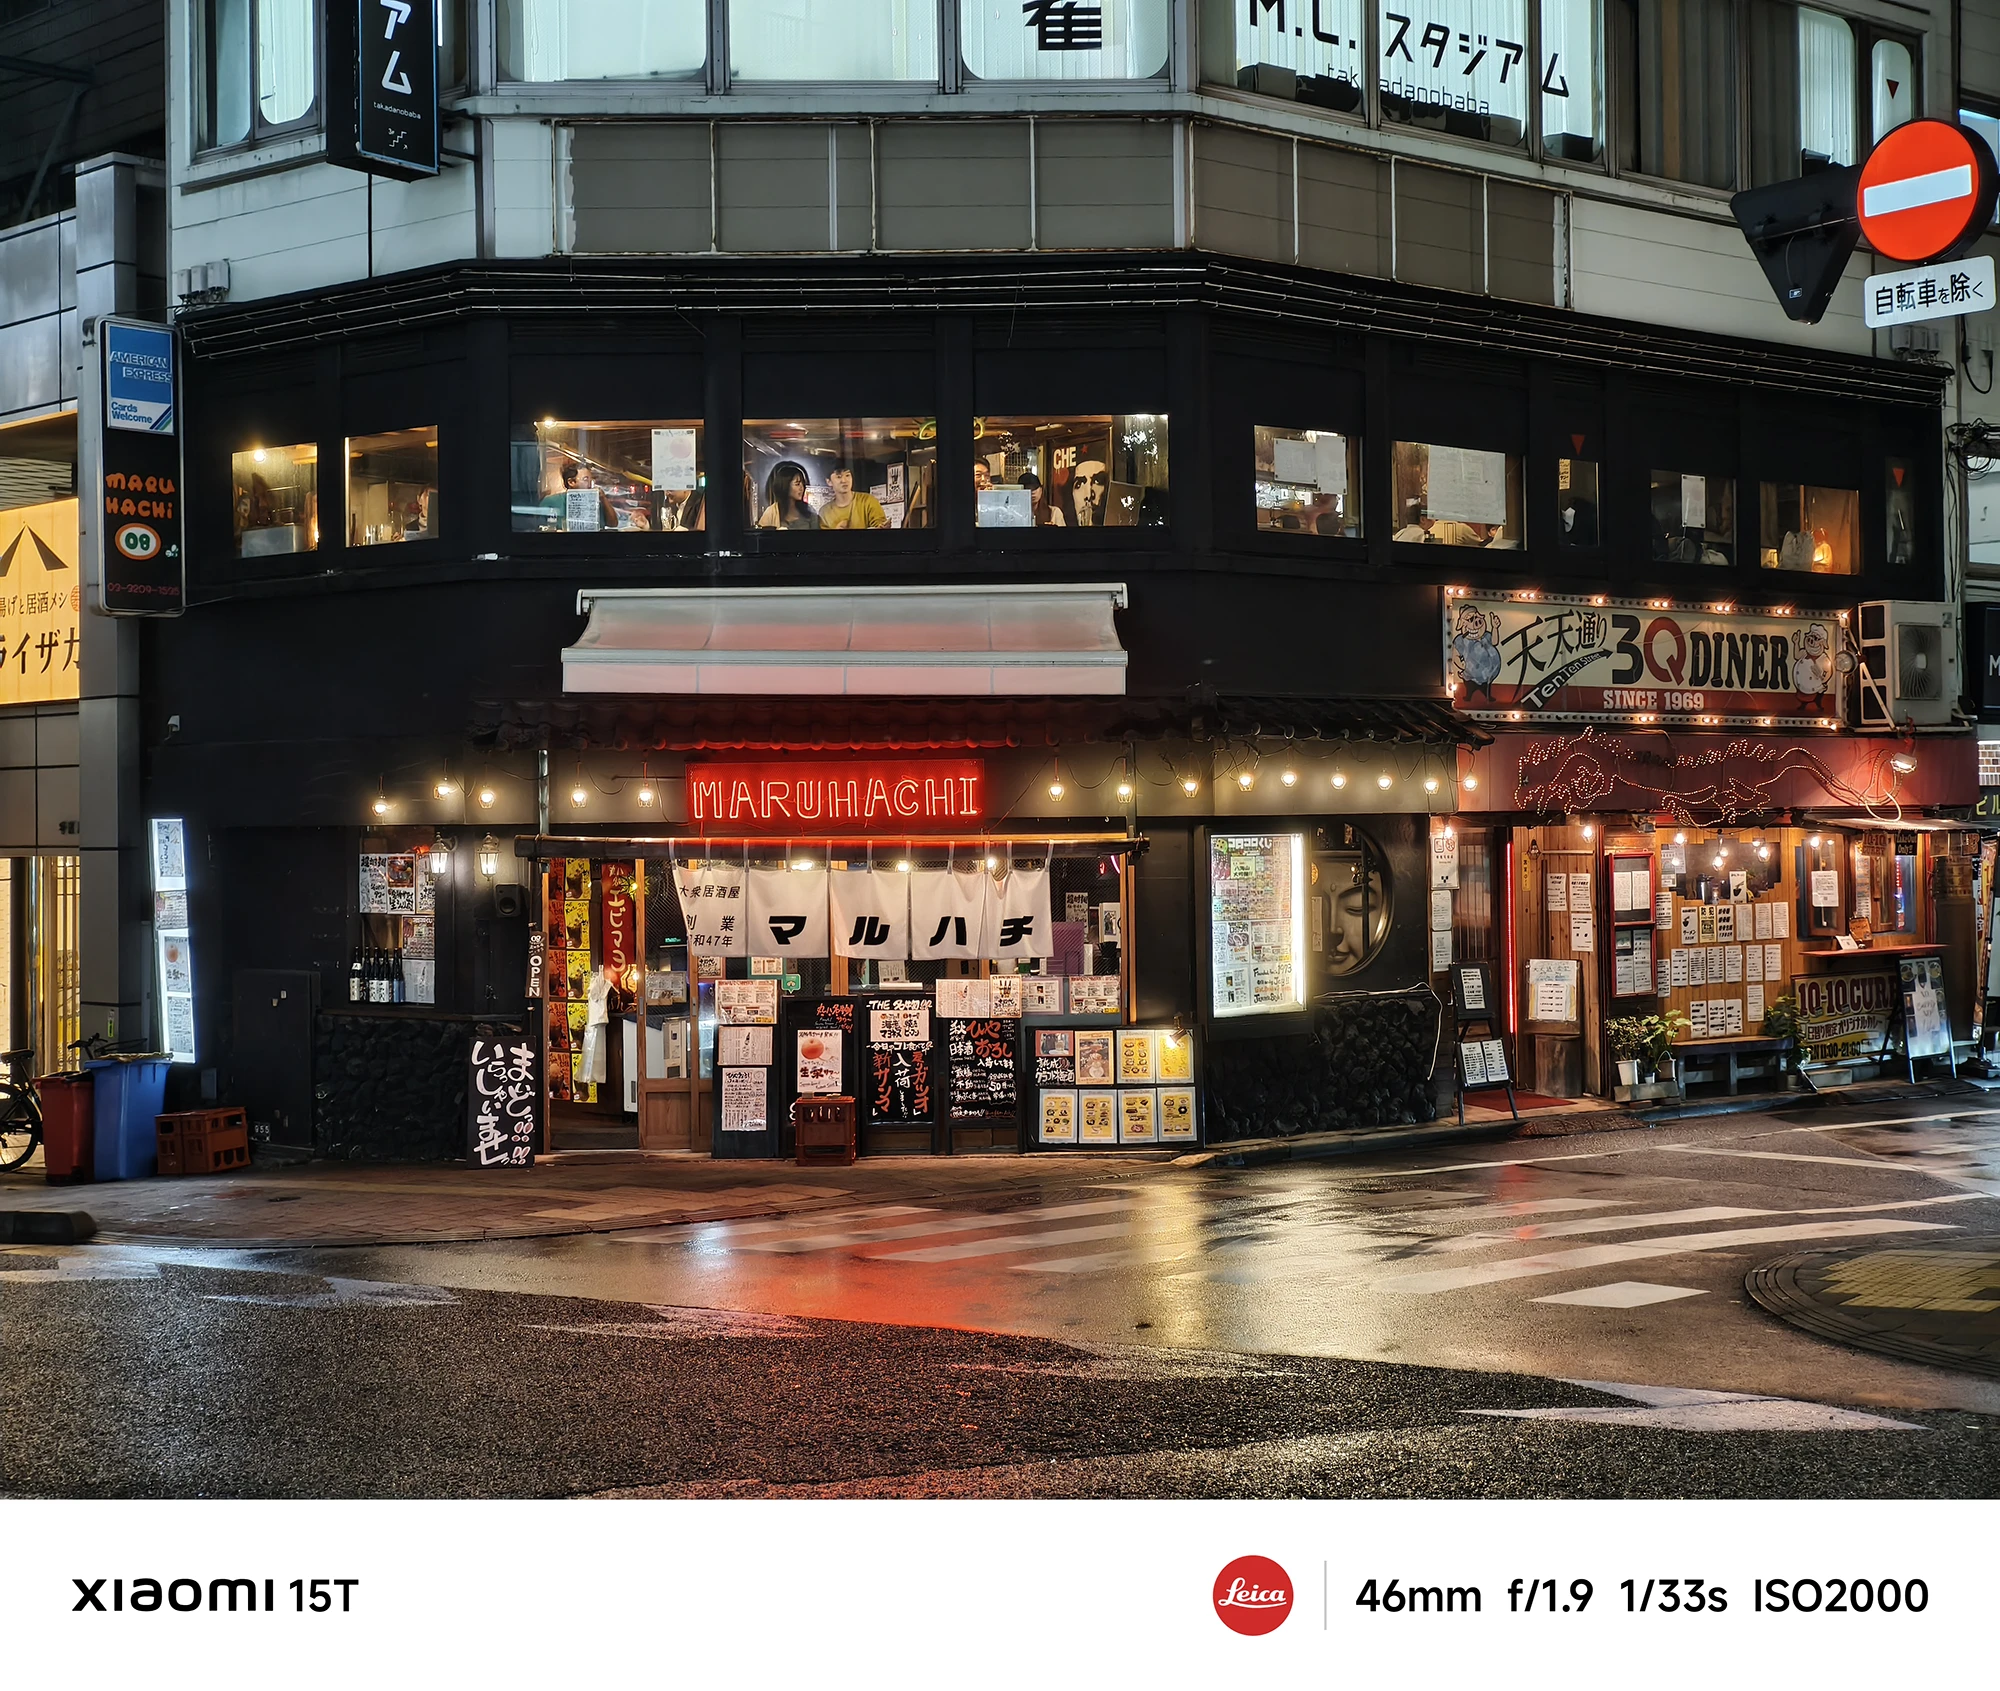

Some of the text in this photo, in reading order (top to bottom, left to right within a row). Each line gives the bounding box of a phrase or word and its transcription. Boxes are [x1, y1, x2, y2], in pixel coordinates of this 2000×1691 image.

[1386, 12, 1570, 98] スタジアム
[373, 101, 422, 120] takadanobaba
[1876, 272, 1984, 315] 自転車を除く
[109, 351, 168, 369] AMERICAN
[122, 366, 172, 383] EXPRESS
[111, 401, 138, 413] Cards
[111, 411, 153, 424] Welcome
[1053, 446, 1077, 471] CHE
[1501, 609, 1607, 702] 天天通り
[1611, 614, 1791, 690] 3Q DINER
[1603, 690, 1705, 711] SINCE 1969
[692, 777, 978, 819] MARUHACHI
[679, 884, 741, 899] 大衆居酒屋
[607, 889, 627, 972] エビマヨ
[769, 914, 1035, 947] マルハチ
[528, 955, 543, 997] OPEN
